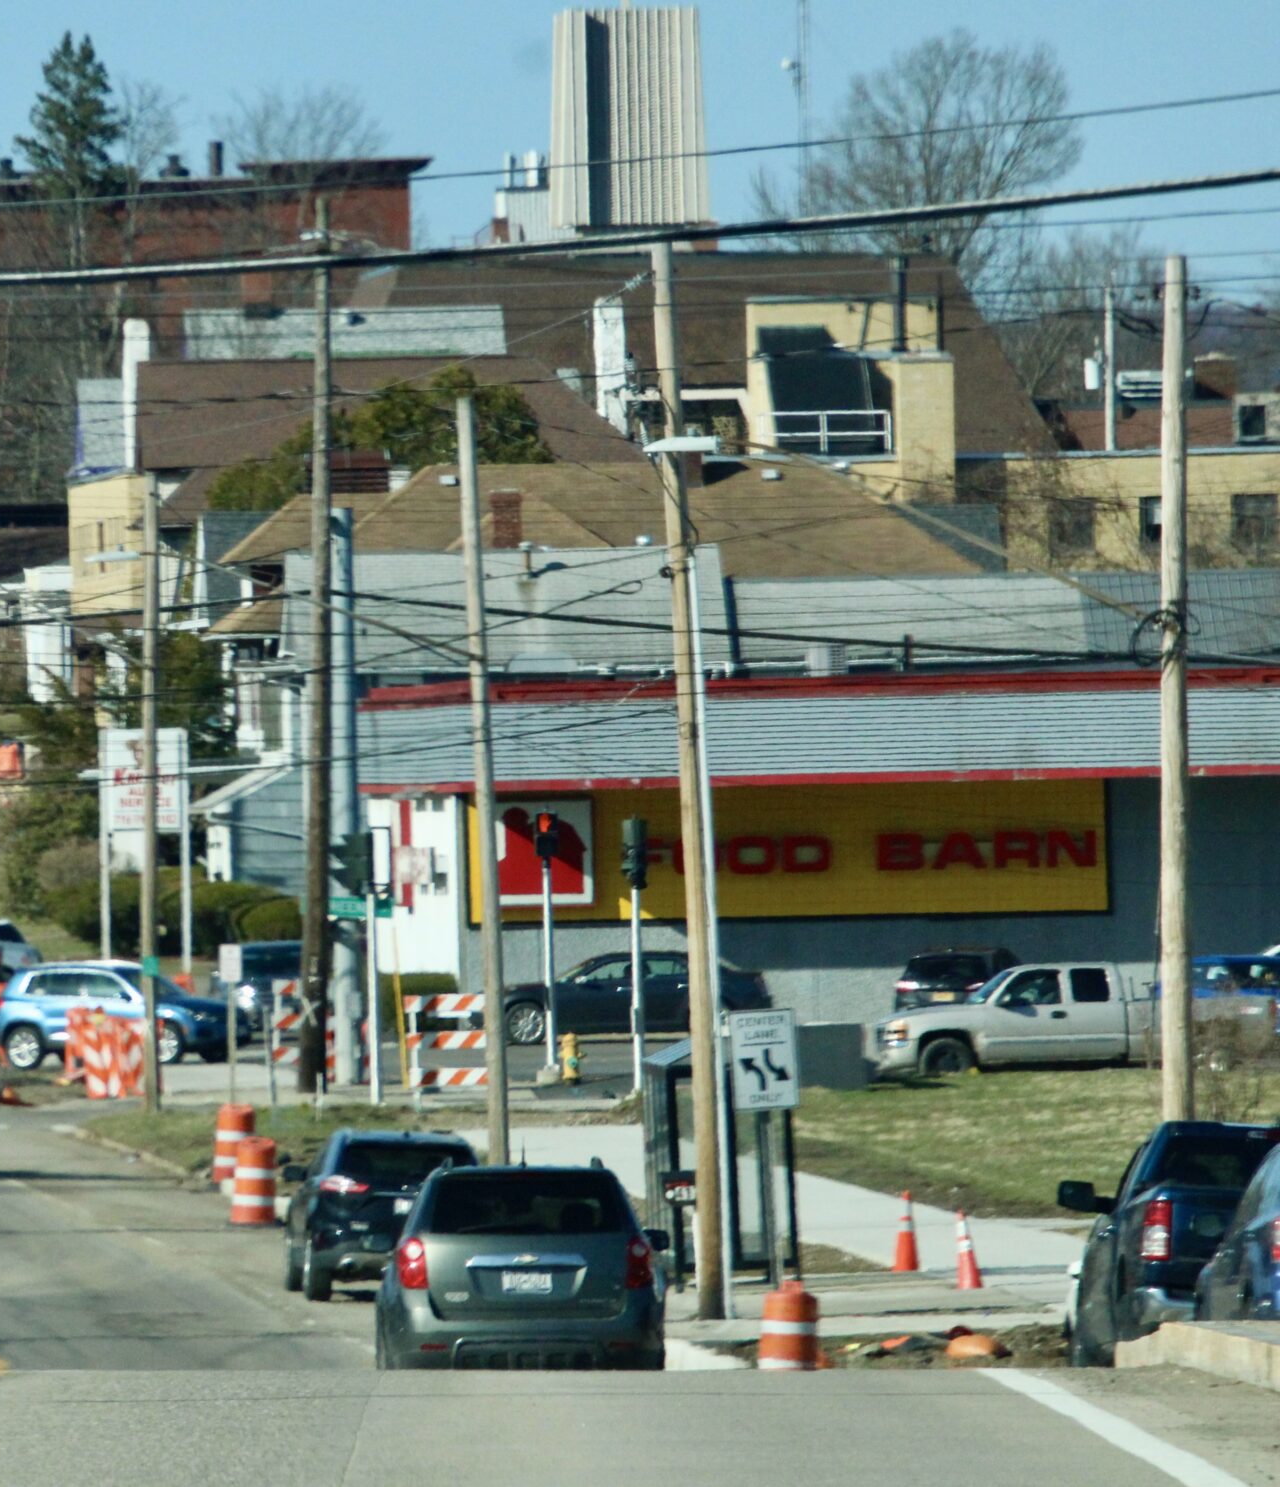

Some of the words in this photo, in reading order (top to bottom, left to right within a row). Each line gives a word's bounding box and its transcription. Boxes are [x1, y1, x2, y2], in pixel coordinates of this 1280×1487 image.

[876, 830, 1097, 872] BARN
[736, 1014, 785, 1029] CENTER
[744, 1029, 779, 1040] LANE
[750, 1093, 783, 1104] ONLY
